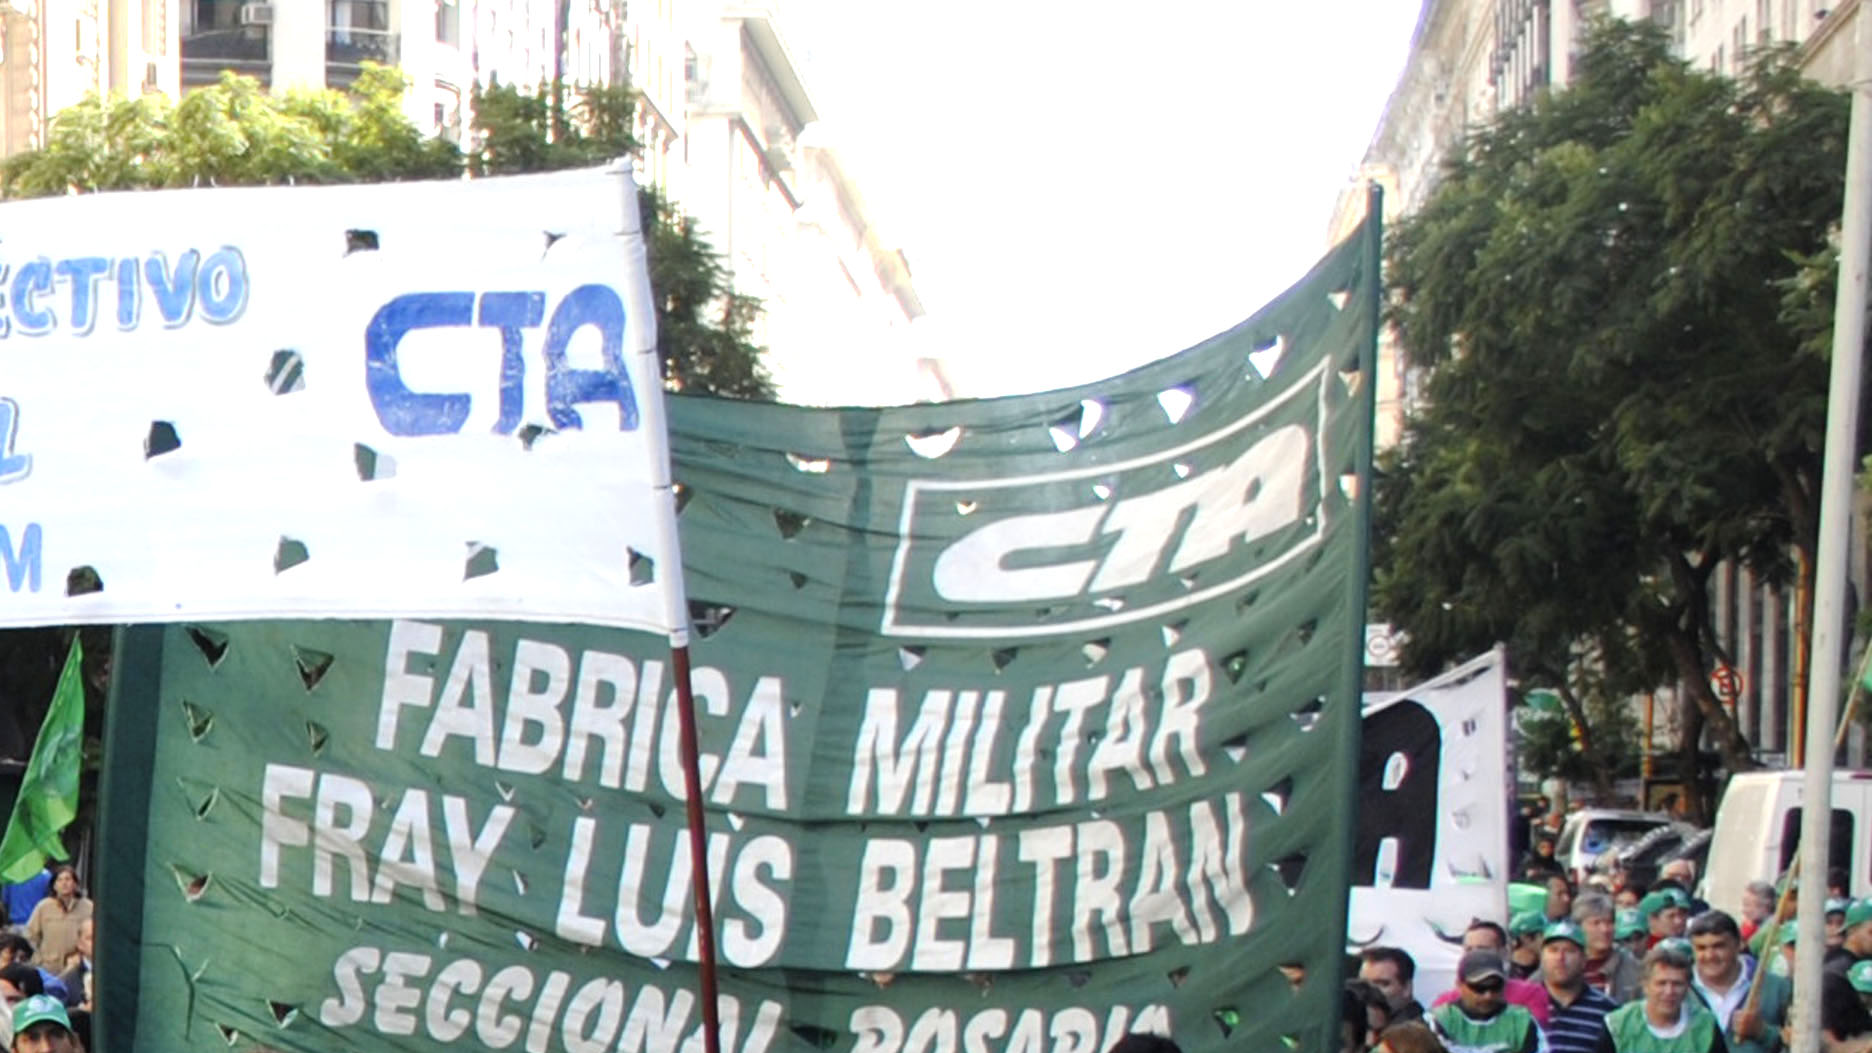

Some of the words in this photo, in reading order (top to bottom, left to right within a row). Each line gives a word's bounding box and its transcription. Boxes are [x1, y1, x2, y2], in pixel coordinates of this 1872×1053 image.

[364, 283, 640, 436] CTA
[932, 424, 1310, 602] CTA
[375, 619, 788, 813] FABRICA
[846, 647, 1213, 818] MILITAR
[259, 763, 519, 917] FRAY
[555, 815, 793, 970] LUIS
[845, 792, 1254, 972] BELTRAN
